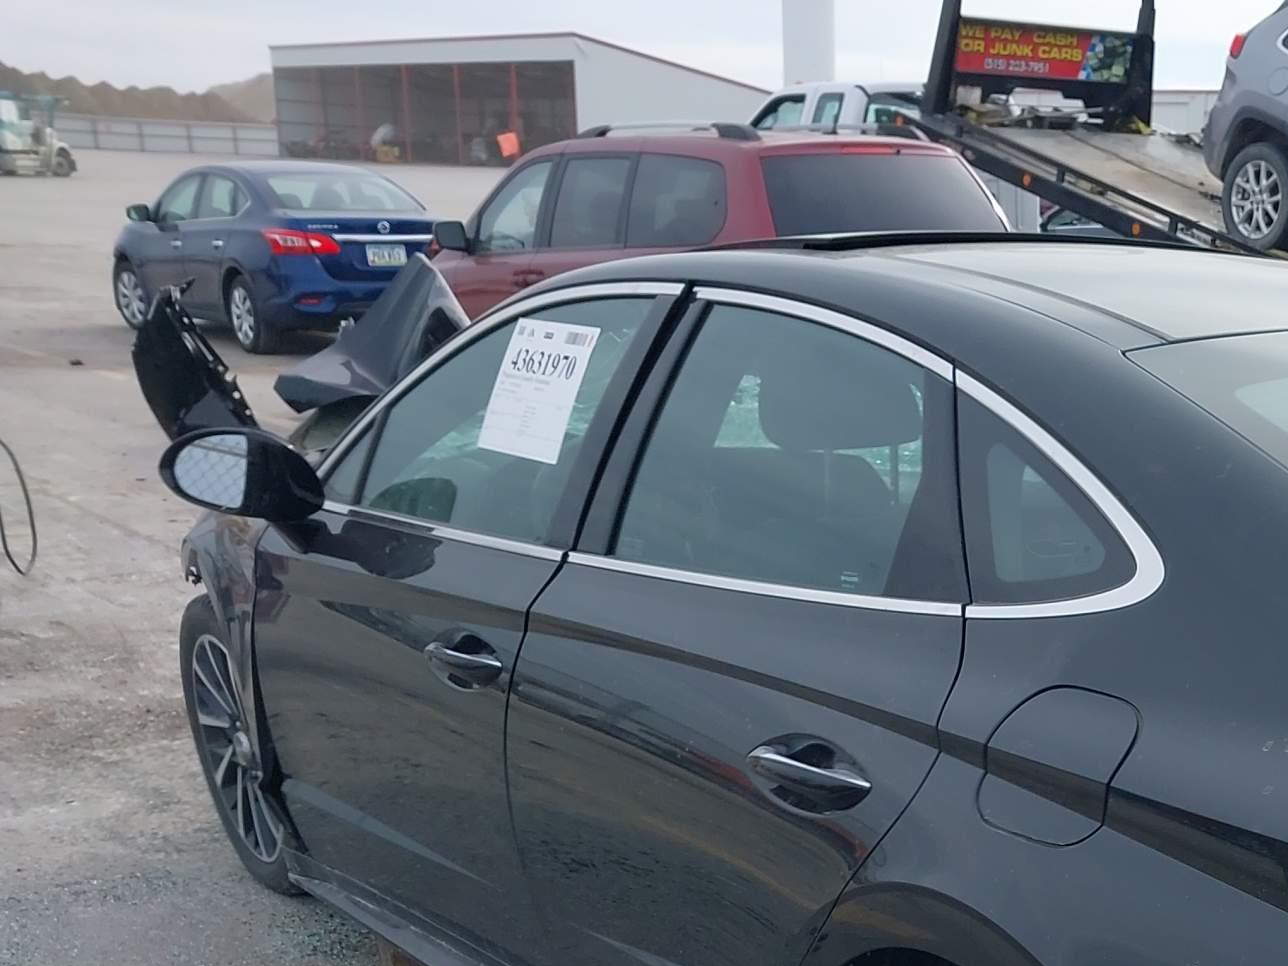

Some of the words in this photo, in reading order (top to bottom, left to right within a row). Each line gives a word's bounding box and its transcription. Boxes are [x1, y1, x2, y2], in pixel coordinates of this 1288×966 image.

[960, 23, 985, 38] WE
[990, 26, 1023, 41] PAY
[1033, 31, 1078, 47] CASH
[959, 38, 985, 53] OR
[989, 41, 1033, 57] JUNK
[1038, 46, 1083, 62] CARS
[511, 348, 577, 380] 43631970
